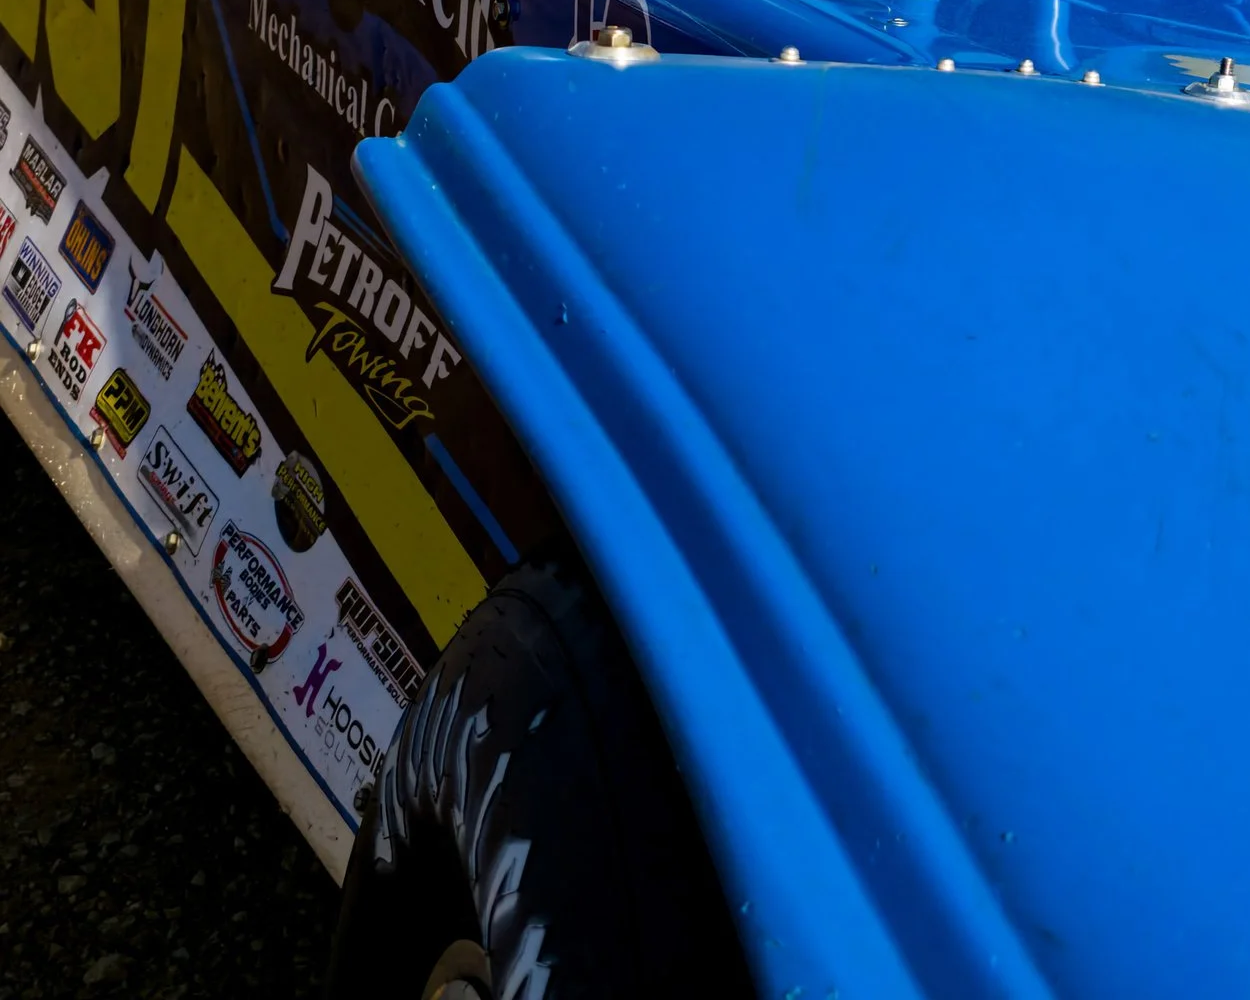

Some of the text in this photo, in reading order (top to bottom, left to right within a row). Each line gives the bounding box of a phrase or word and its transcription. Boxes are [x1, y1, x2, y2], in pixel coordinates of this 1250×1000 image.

[22, 143, 63, 198] MARLAR
[20, 242, 59, 298] WINNING
[273, 163, 463, 390] PETROFF
[133, 294, 185, 364] LONGHORN
[48, 348, 81, 401] ENDS
[60, 342, 87, 384] ROD
[308, 301, 436, 430] Towing
[104, 376, 147, 430] PPM
[294, 462, 325, 504] HIGH
[222, 524, 304, 632] PERFORMANCE
[239, 568, 272, 611] BODIES
[225, 590, 261, 639] PARTS
[344, 622, 389, 687] PERFORMANCE
[314, 716, 366, 786] SOUTH
